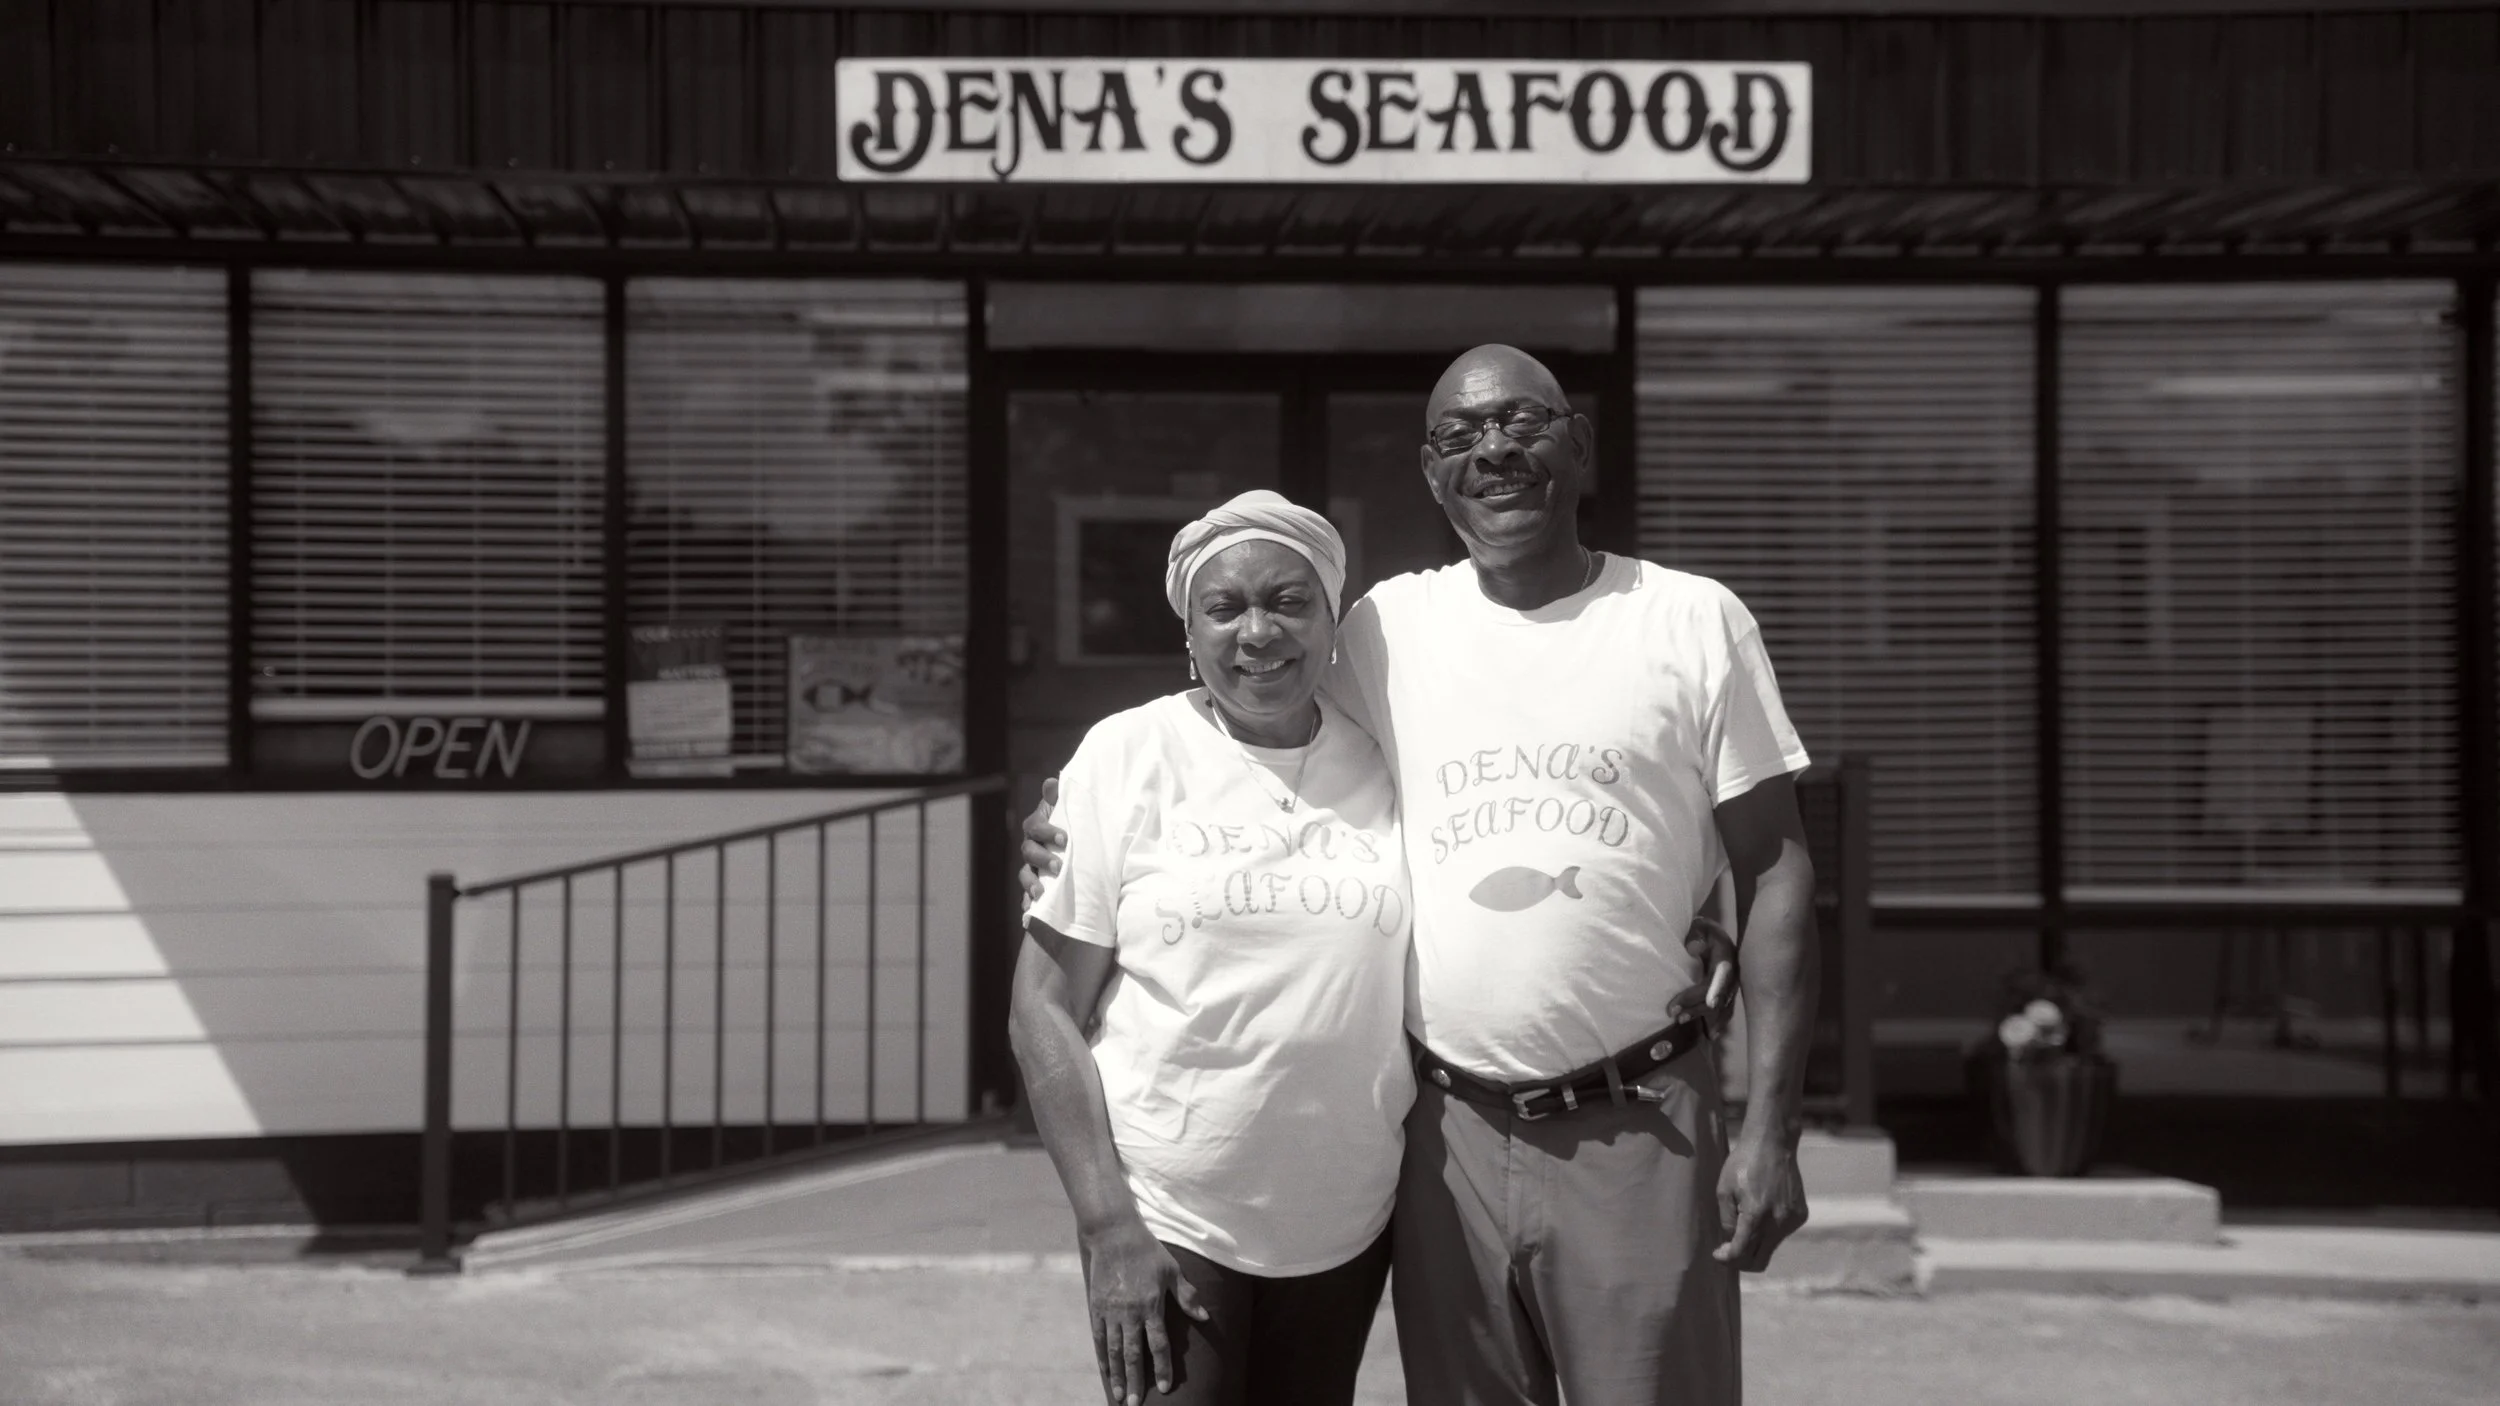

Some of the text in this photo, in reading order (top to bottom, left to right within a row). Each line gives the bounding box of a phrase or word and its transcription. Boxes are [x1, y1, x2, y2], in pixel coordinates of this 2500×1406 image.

[850, 66, 1792, 179] DENA'S SEAFOOD
[351, 715, 532, 779] OPEN
[1436, 742, 1623, 798] DENA'S
[1431, 797, 1629, 865] SEAFOOD
